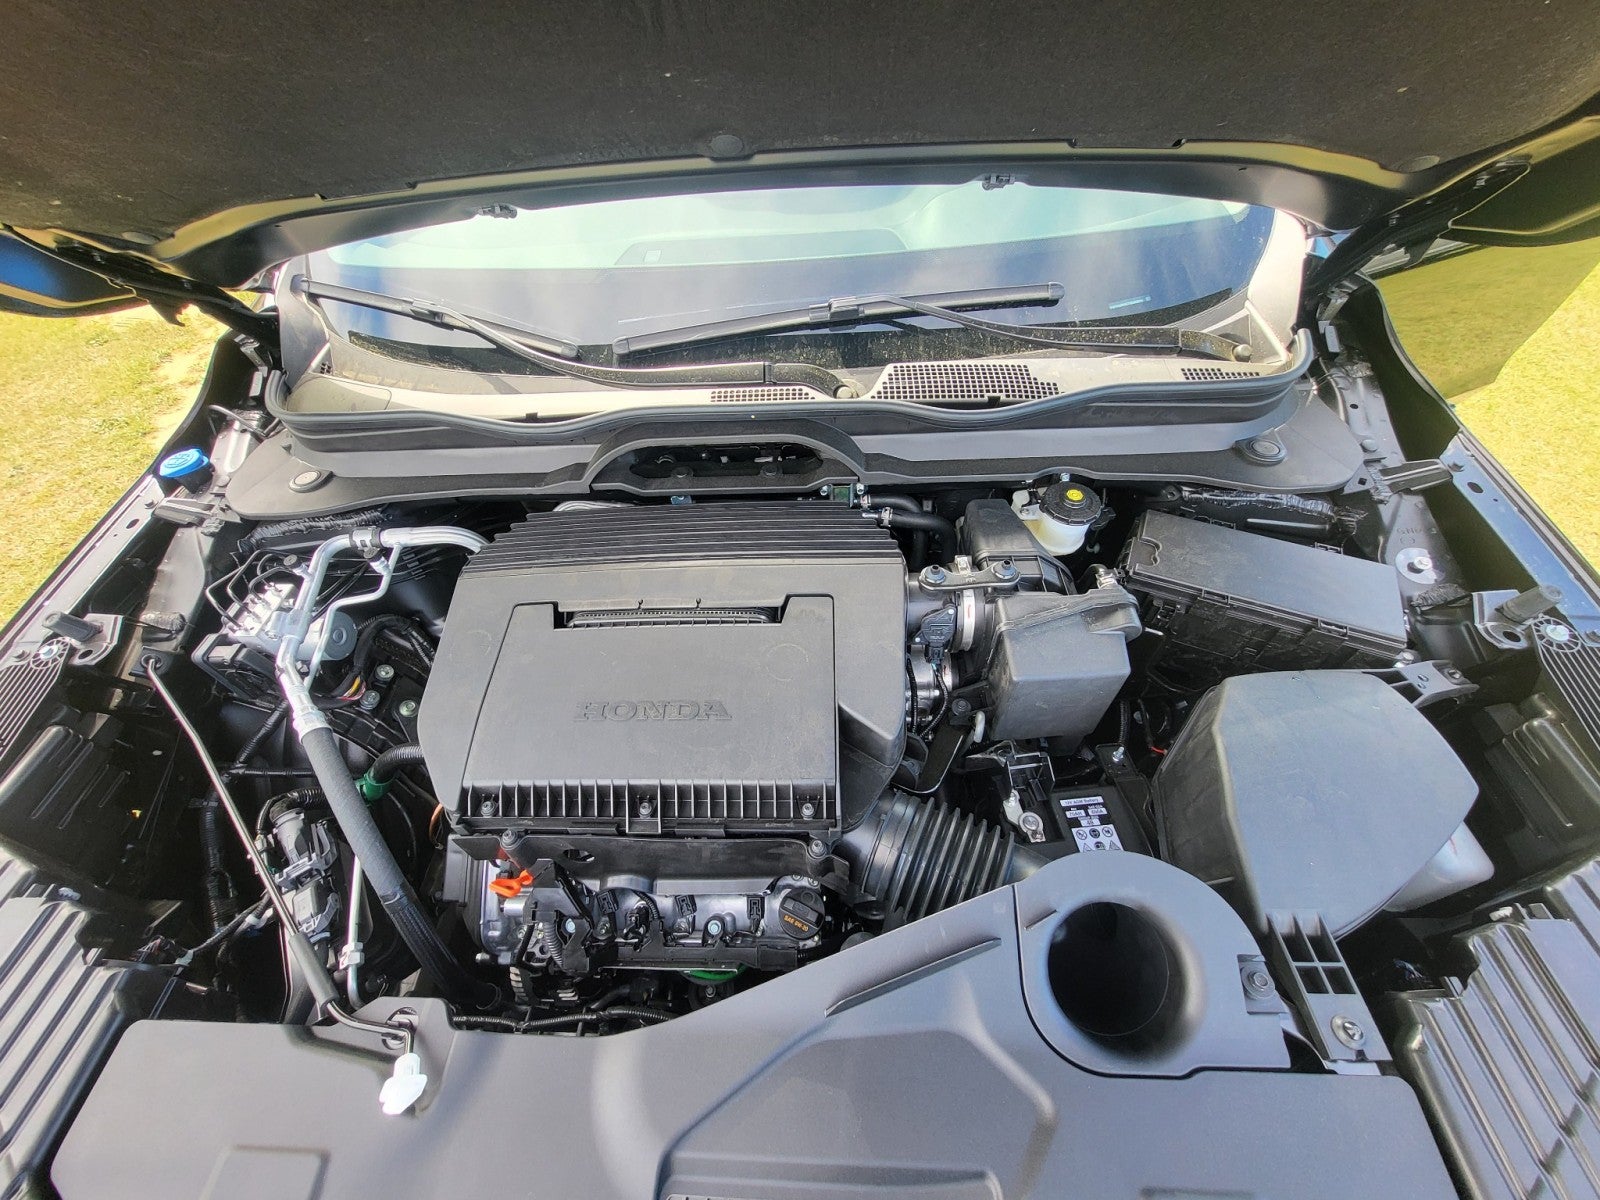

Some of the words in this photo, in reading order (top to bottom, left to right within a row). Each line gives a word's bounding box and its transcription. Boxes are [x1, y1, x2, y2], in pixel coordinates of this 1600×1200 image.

[574, 701, 733, 722] HONDA
[783, 914, 795, 924] SAE
[794, 920, 809, 932] 0W-20
